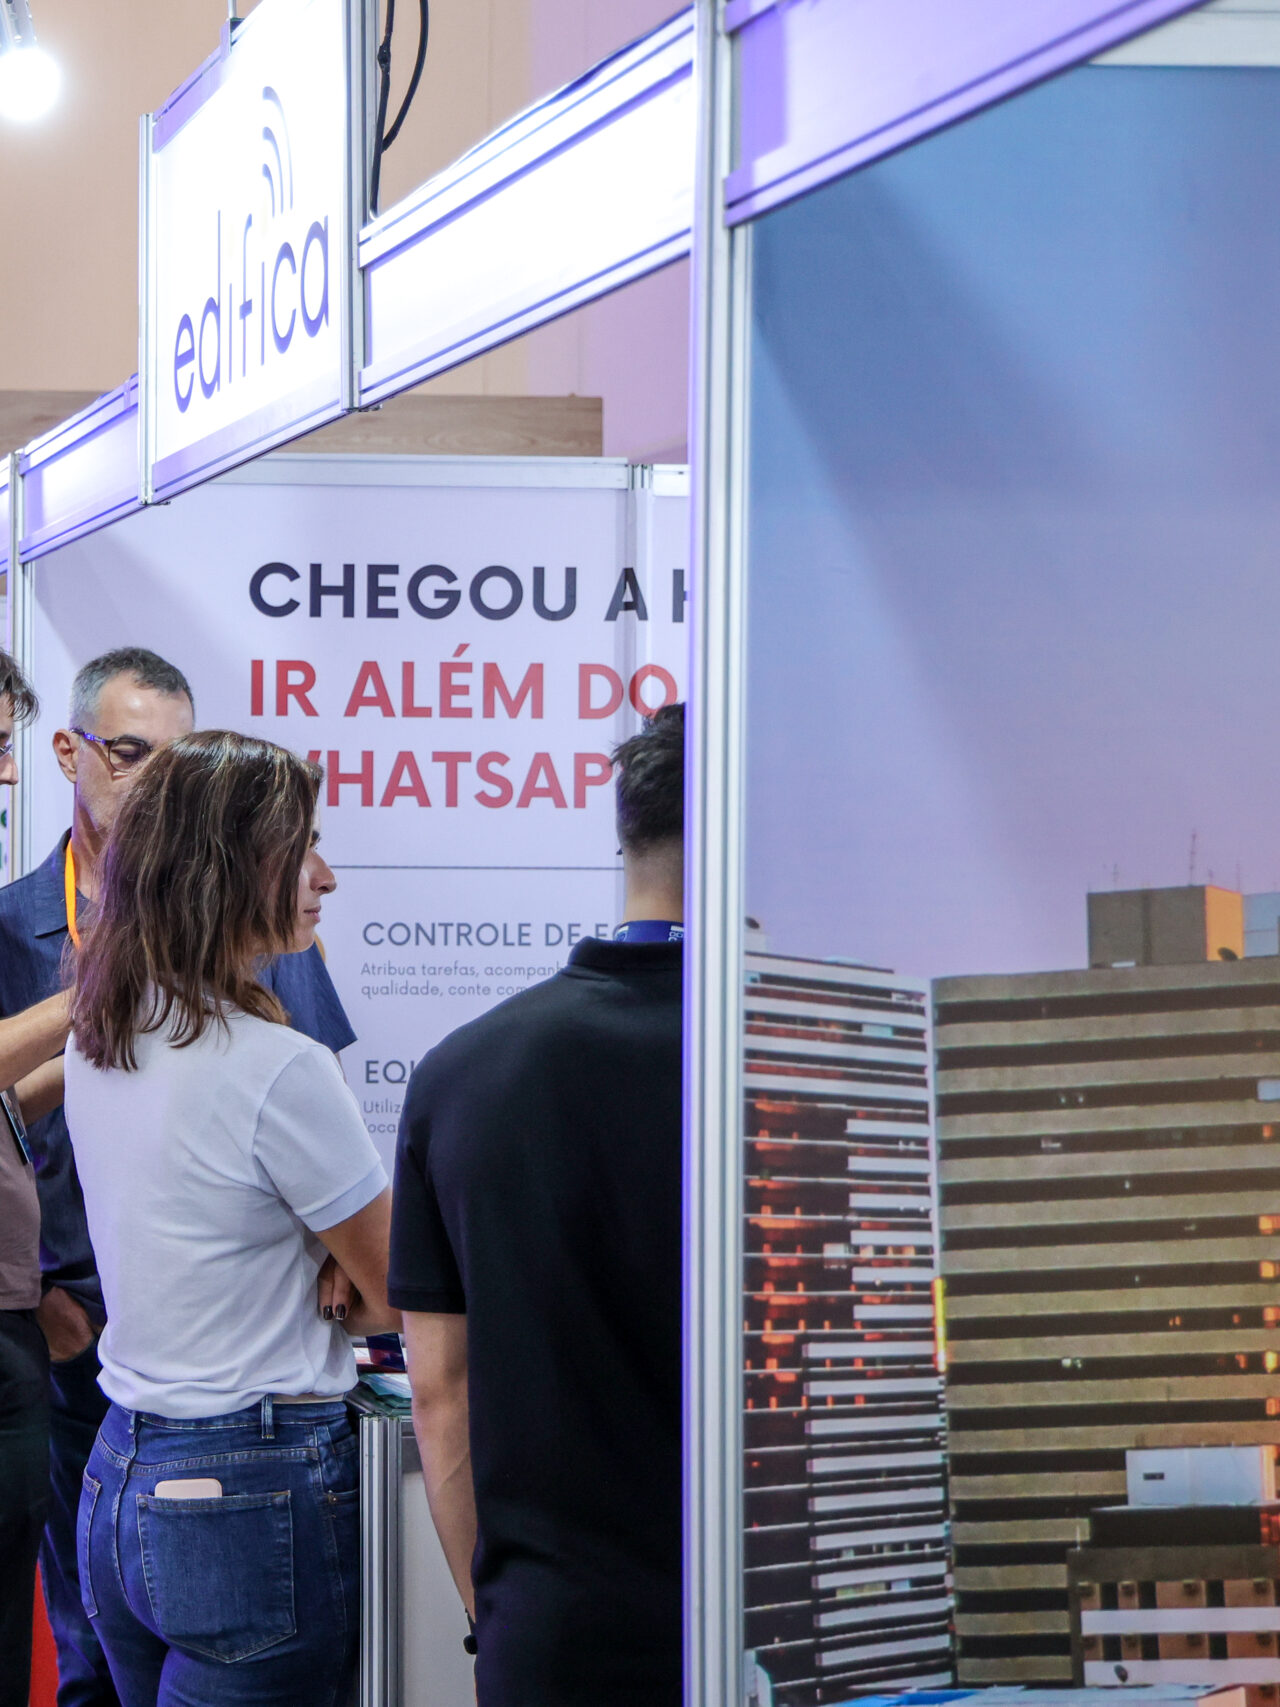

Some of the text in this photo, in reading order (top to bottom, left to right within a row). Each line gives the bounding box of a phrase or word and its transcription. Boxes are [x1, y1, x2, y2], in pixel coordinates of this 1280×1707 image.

[173, 209, 329, 413] edifica
[249, 562, 577, 621] CHEGOU
[604, 567, 649, 622] A
[251, 643, 678, 719] IR ALÉM DO
[306, 750, 613, 808] HATSAP
[362, 922, 532, 947] CONTROLE
[545, 923, 581, 947] DE
[360, 961, 416, 976] Atribua
[422, 960, 479, 978] tarefas,
[361, 981, 443, 999] qualidade,
[448, 983, 491, 996] conte
[363, 1098, 401, 1114] Utiliz
